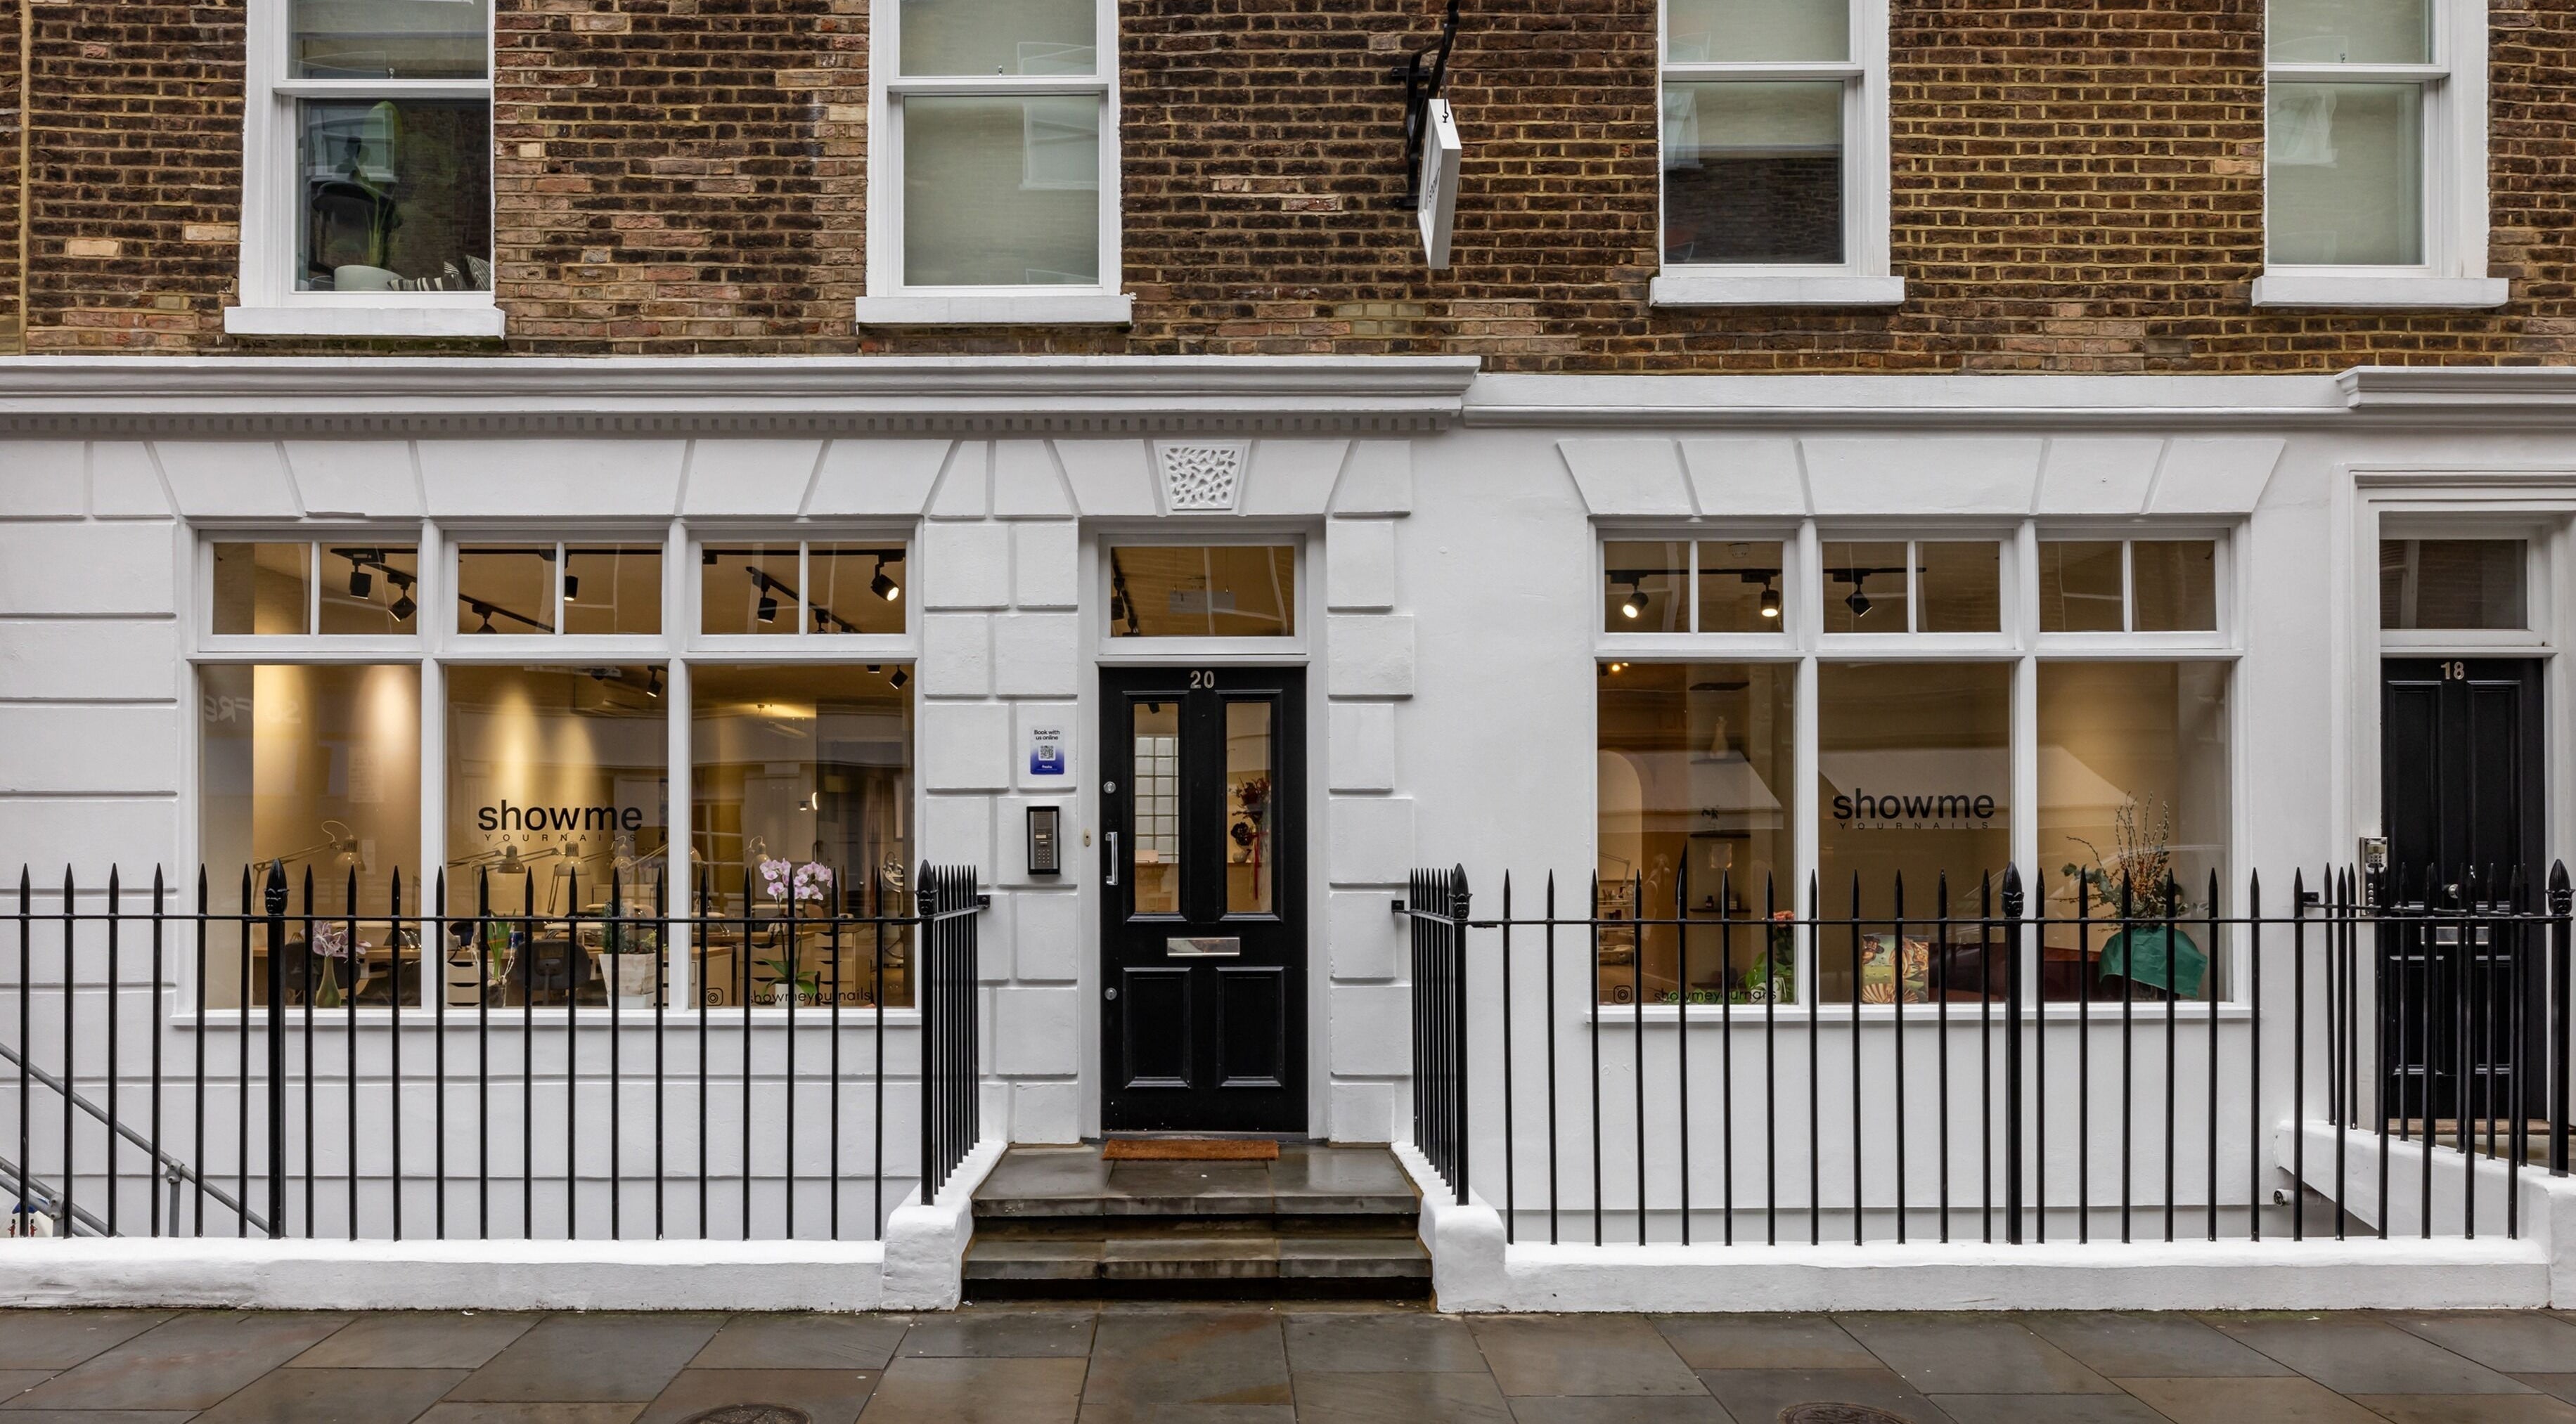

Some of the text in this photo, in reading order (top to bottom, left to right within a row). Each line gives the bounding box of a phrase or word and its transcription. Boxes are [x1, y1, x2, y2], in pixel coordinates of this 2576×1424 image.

[1190, 670, 1216, 689] 20
[2440, 661, 2465, 680] 18
[1832, 787, 1995, 820] showme
[477, 798, 643, 831] showme
[1839, 822, 1989, 830] YOURNAILS
[484, 834, 637, 842] YOURNAILS
[749, 987, 871, 1006] howeyounails
[1654, 988, 1777, 1004] shomeyurnais
